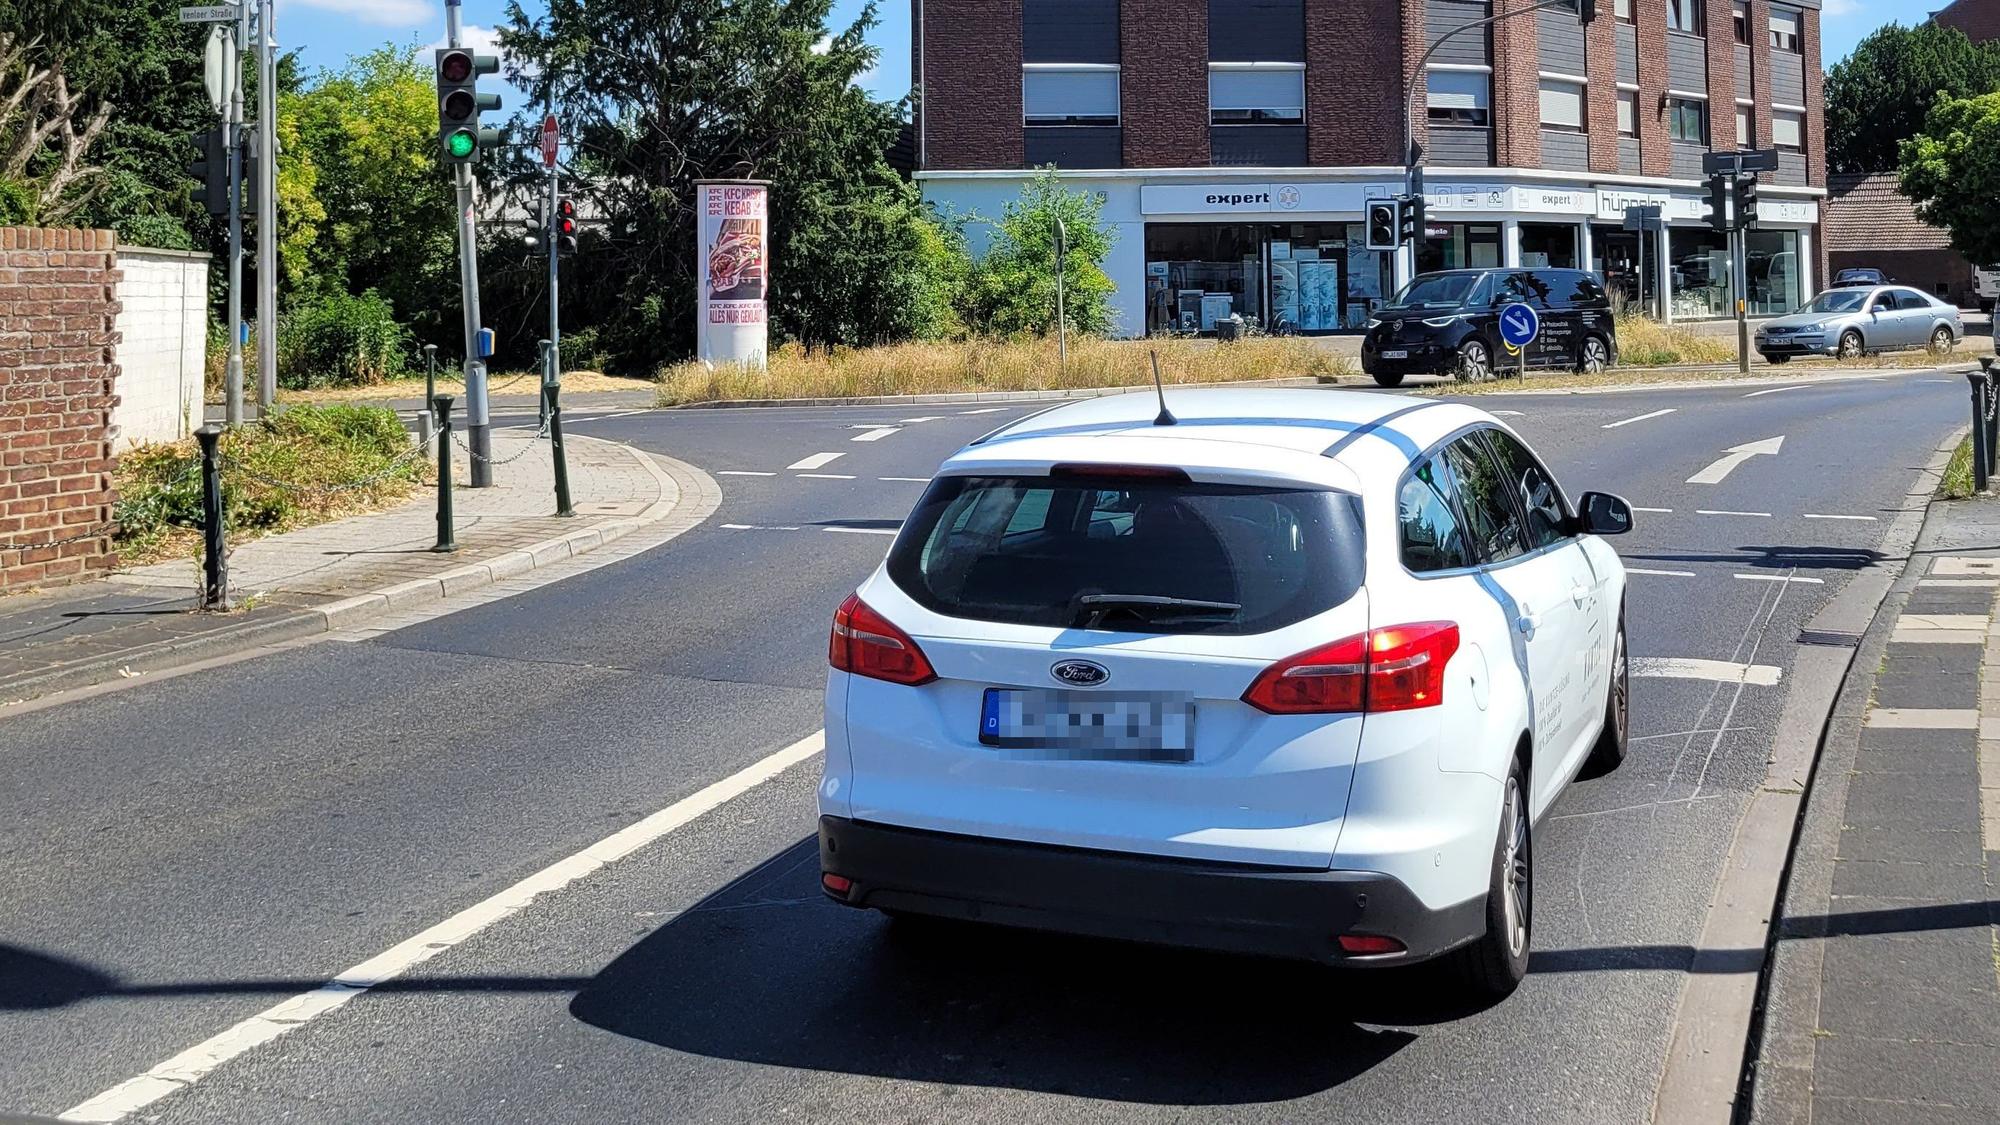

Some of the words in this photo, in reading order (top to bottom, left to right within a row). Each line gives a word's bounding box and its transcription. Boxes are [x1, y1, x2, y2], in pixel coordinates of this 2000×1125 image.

[183, 10, 207, 19] Venloer
[210, 8, 233, 18] Straße
[544, 130, 557, 154] STOP
[724, 188, 740, 200] KFC
[1206, 192, 1270, 206] expert
[1542, 194, 1571, 206] expert
[724, 201, 751, 216] KEBAB
[709, 310, 726, 324] ALLES
[726, 310, 740, 324] NUR
[1063, 664, 1096, 681] Ford
[988, 717, 997, 728] D
